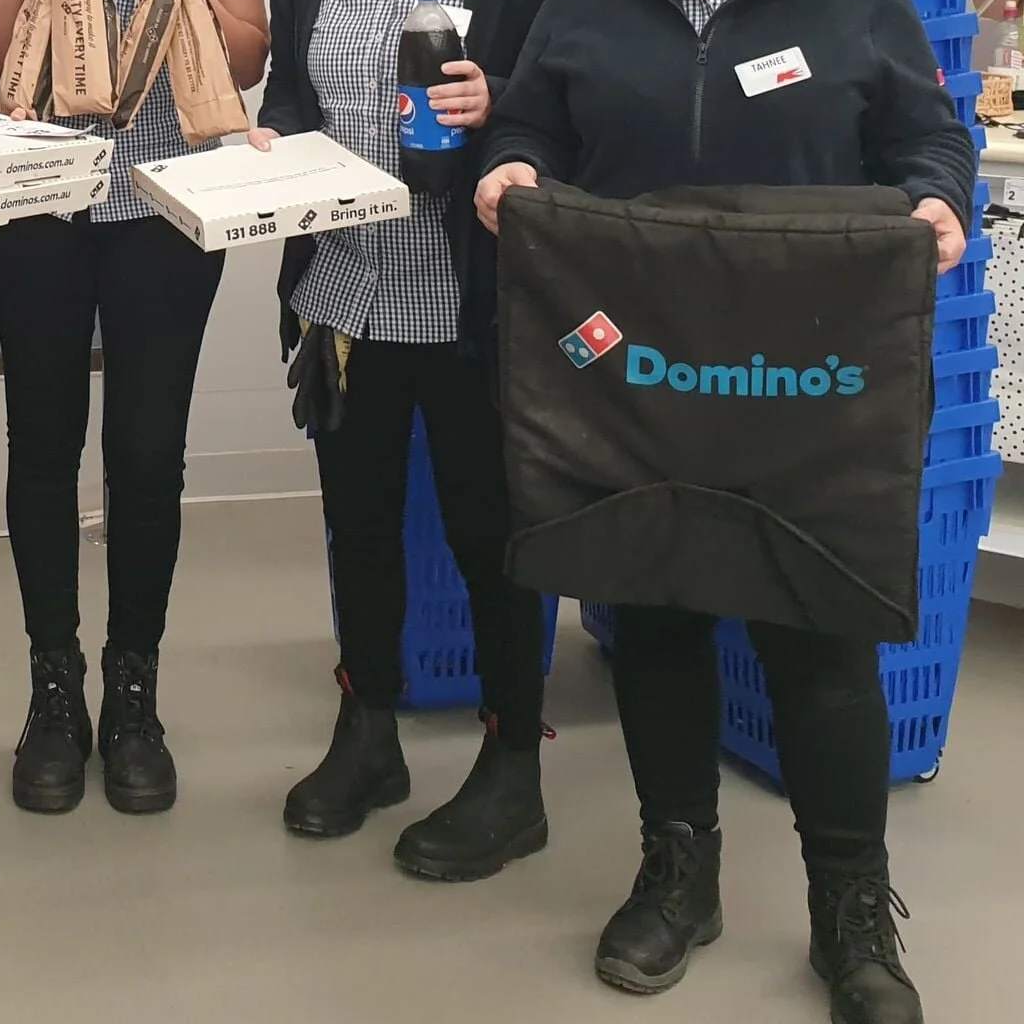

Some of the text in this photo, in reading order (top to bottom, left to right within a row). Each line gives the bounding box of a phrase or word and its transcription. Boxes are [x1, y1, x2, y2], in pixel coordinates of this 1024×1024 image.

[74, 21, 85, 60] EVERY
[750, 55, 787, 73] TAHNEE
[5, 69, 22, 100] TIME
[75, 64, 86, 96] TIME
[6, 157, 75, 174] dominos.com.au
[0, 190, 71, 210] dominos.com.au
[331, 208, 367, 223] Bring
[369, 203, 380, 215] it
[225, 221, 277, 241] 131 888
[626, 343, 865, 397] Domino's
